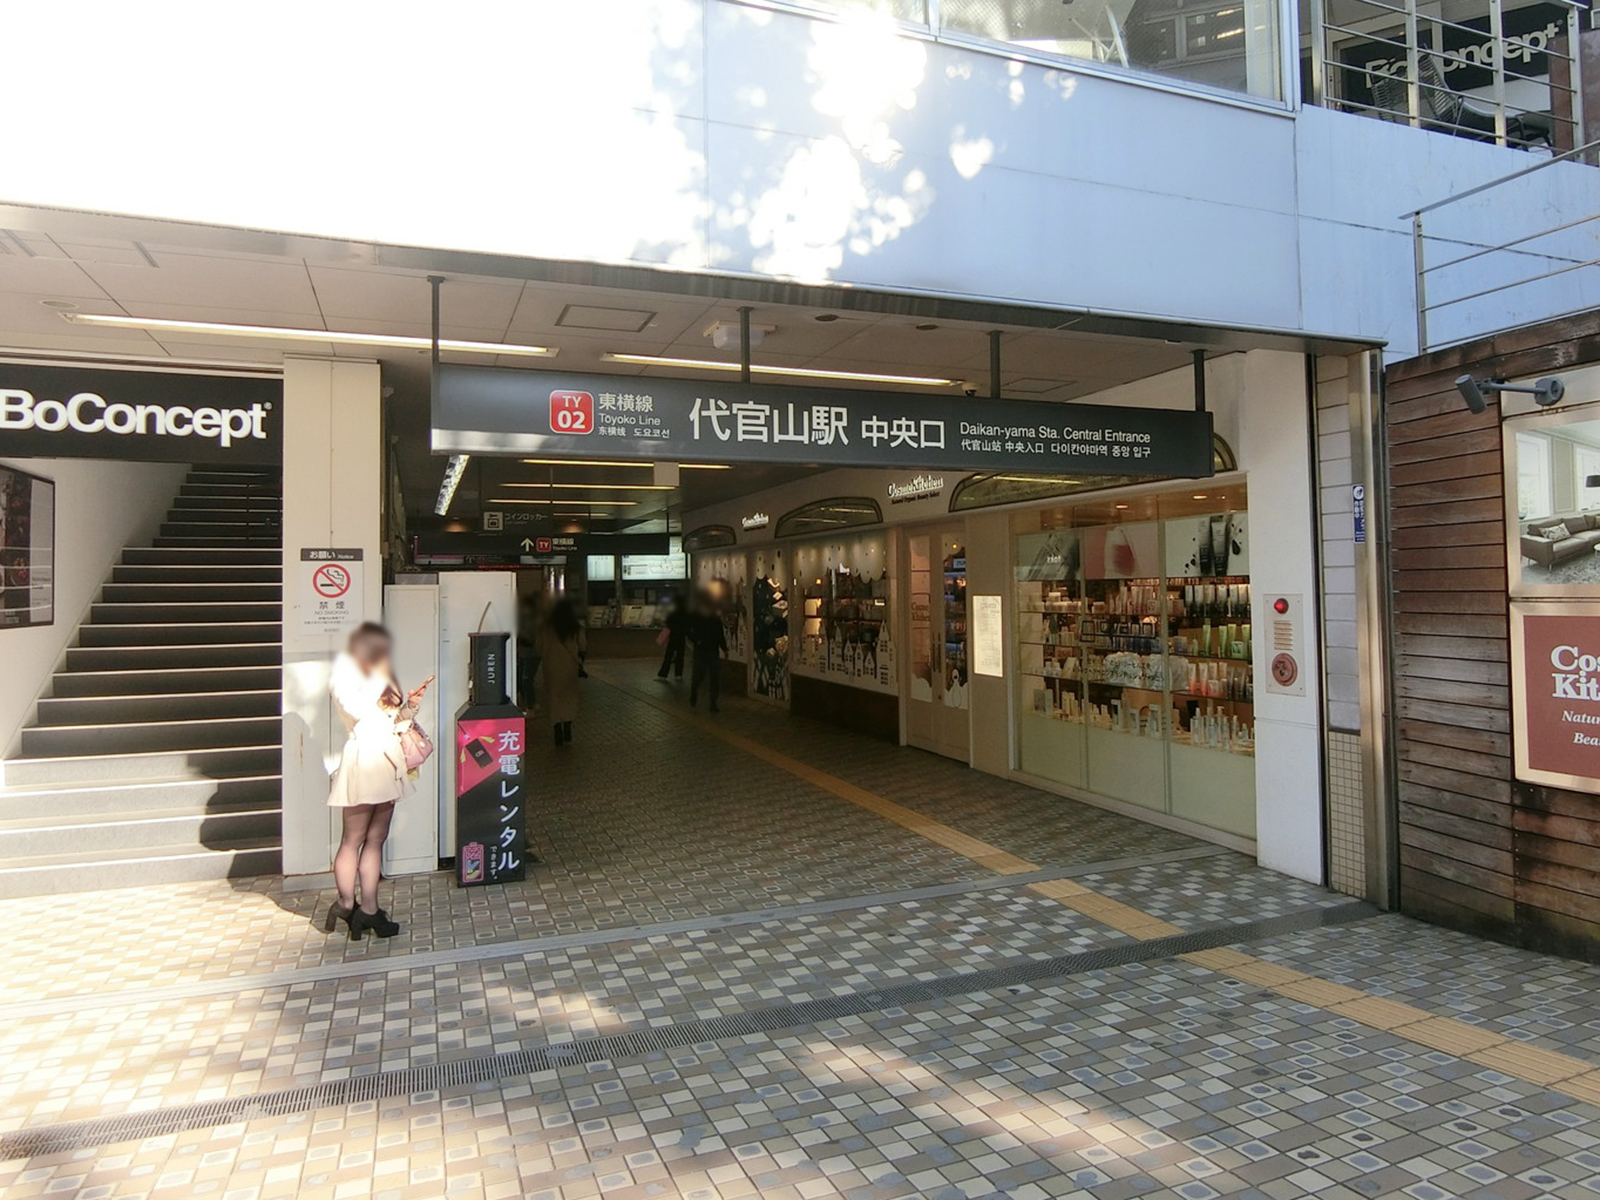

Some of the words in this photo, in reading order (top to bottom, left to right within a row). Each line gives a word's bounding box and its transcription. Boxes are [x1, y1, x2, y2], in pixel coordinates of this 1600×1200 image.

[562, 395, 582, 408] TY
[598, 392, 653, 413] 東横線
[0, 389, 267, 447] BoConcept
[557, 410, 586, 429] 02
[598, 413, 636, 426] Toyoko
[638, 414, 661, 426] Line
[689, 398, 849, 446] 代官山駅
[861, 415, 945, 449] 中央口
[633, 427, 670, 439] 도요코선
[960, 422, 1036, 439] Daikan-yama
[1038, 425, 1060, 439] Sta.
[1063, 427, 1102, 441] Central
[1105, 429, 1151, 443] Entrance
[961, 439, 1002, 453] 代官山站
[309, 551, 336, 559] お願い
[487, 653, 496, 684] JUREN
[498, 731, 520, 870] 充電レンタル
